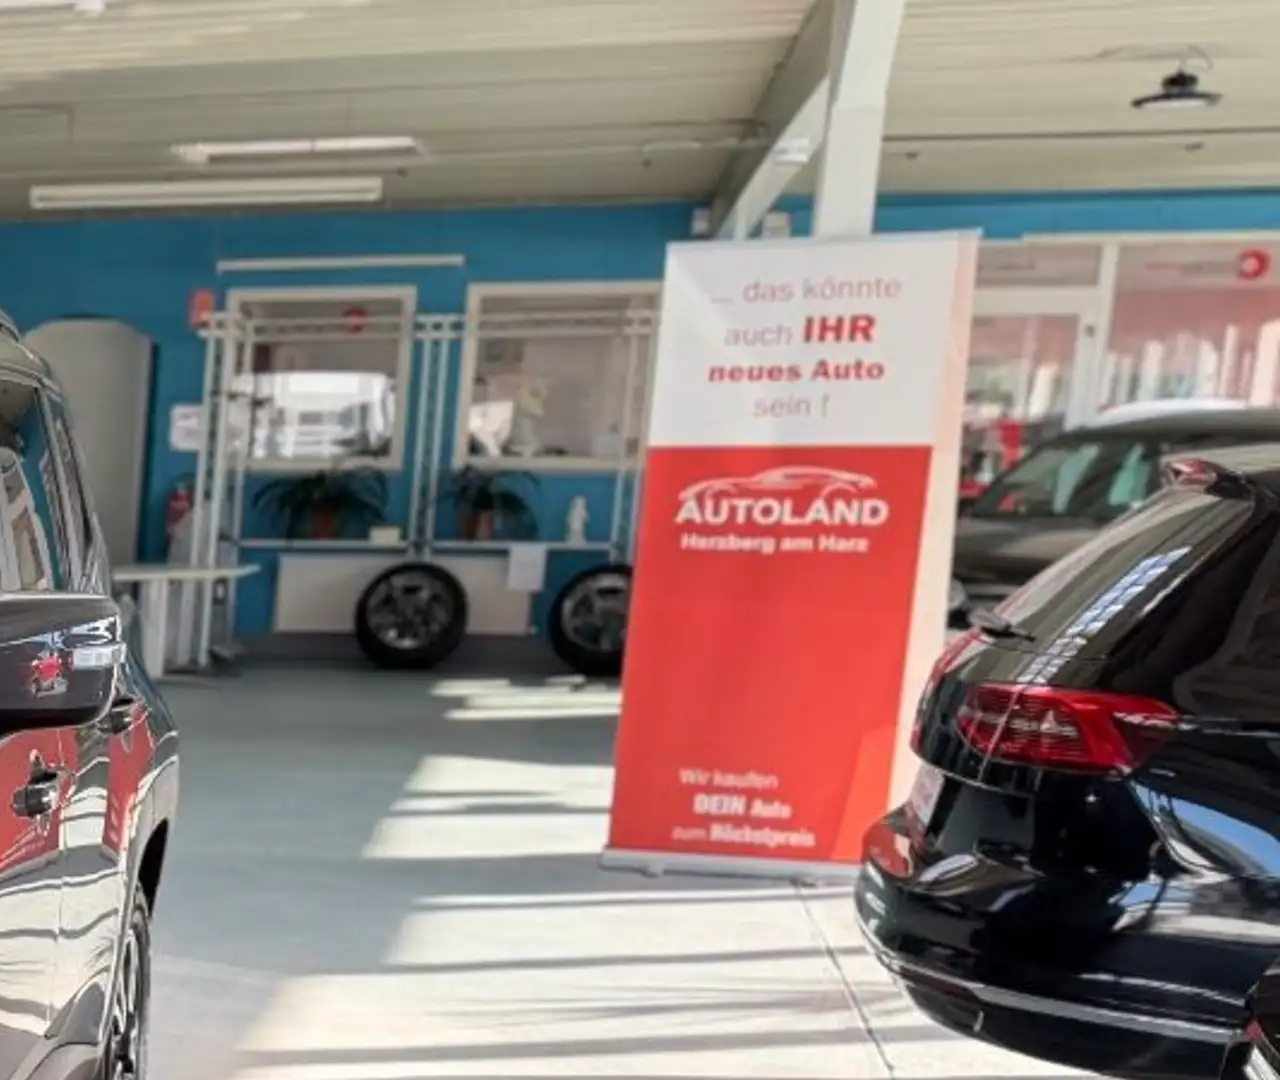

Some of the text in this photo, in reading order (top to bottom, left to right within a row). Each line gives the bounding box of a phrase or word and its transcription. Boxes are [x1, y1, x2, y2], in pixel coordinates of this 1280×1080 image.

[742, 279, 795, 303] das
[801, 275, 902, 299] könnte
[723, 313, 877, 346] auch IHR
[707, 358, 885, 383] neues Auto
[753, 394, 811, 418] sein
[674, 498, 889, 526] AUTOLAND
[780, 536, 813, 551] am
